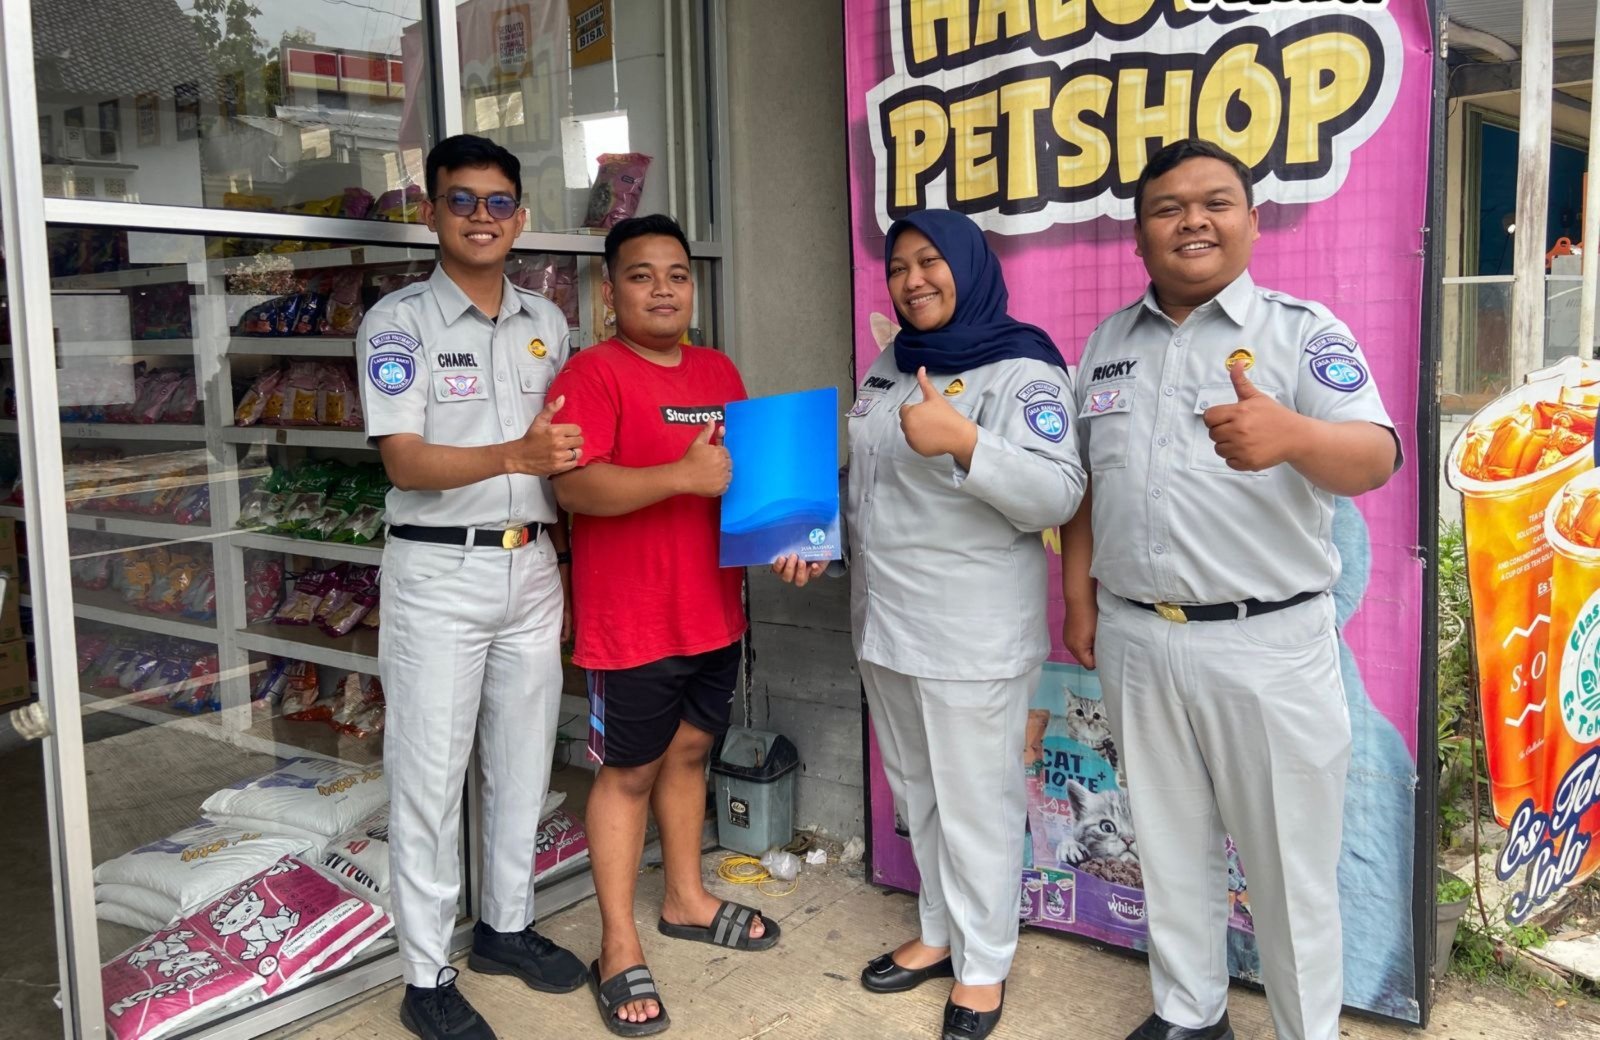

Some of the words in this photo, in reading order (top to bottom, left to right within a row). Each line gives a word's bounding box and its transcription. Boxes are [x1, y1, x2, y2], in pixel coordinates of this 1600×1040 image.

[579, 27, 603, 48] BISA
[888, 32, 1372, 207] PETSHOP
[438, 353, 478, 368] CHARIEL
[1092, 361, 1138, 381] RICKY
[666, 408, 724, 424] Starcross
[1500, 806, 1546, 874] Es
[1511, 824, 1589, 918] Solo
